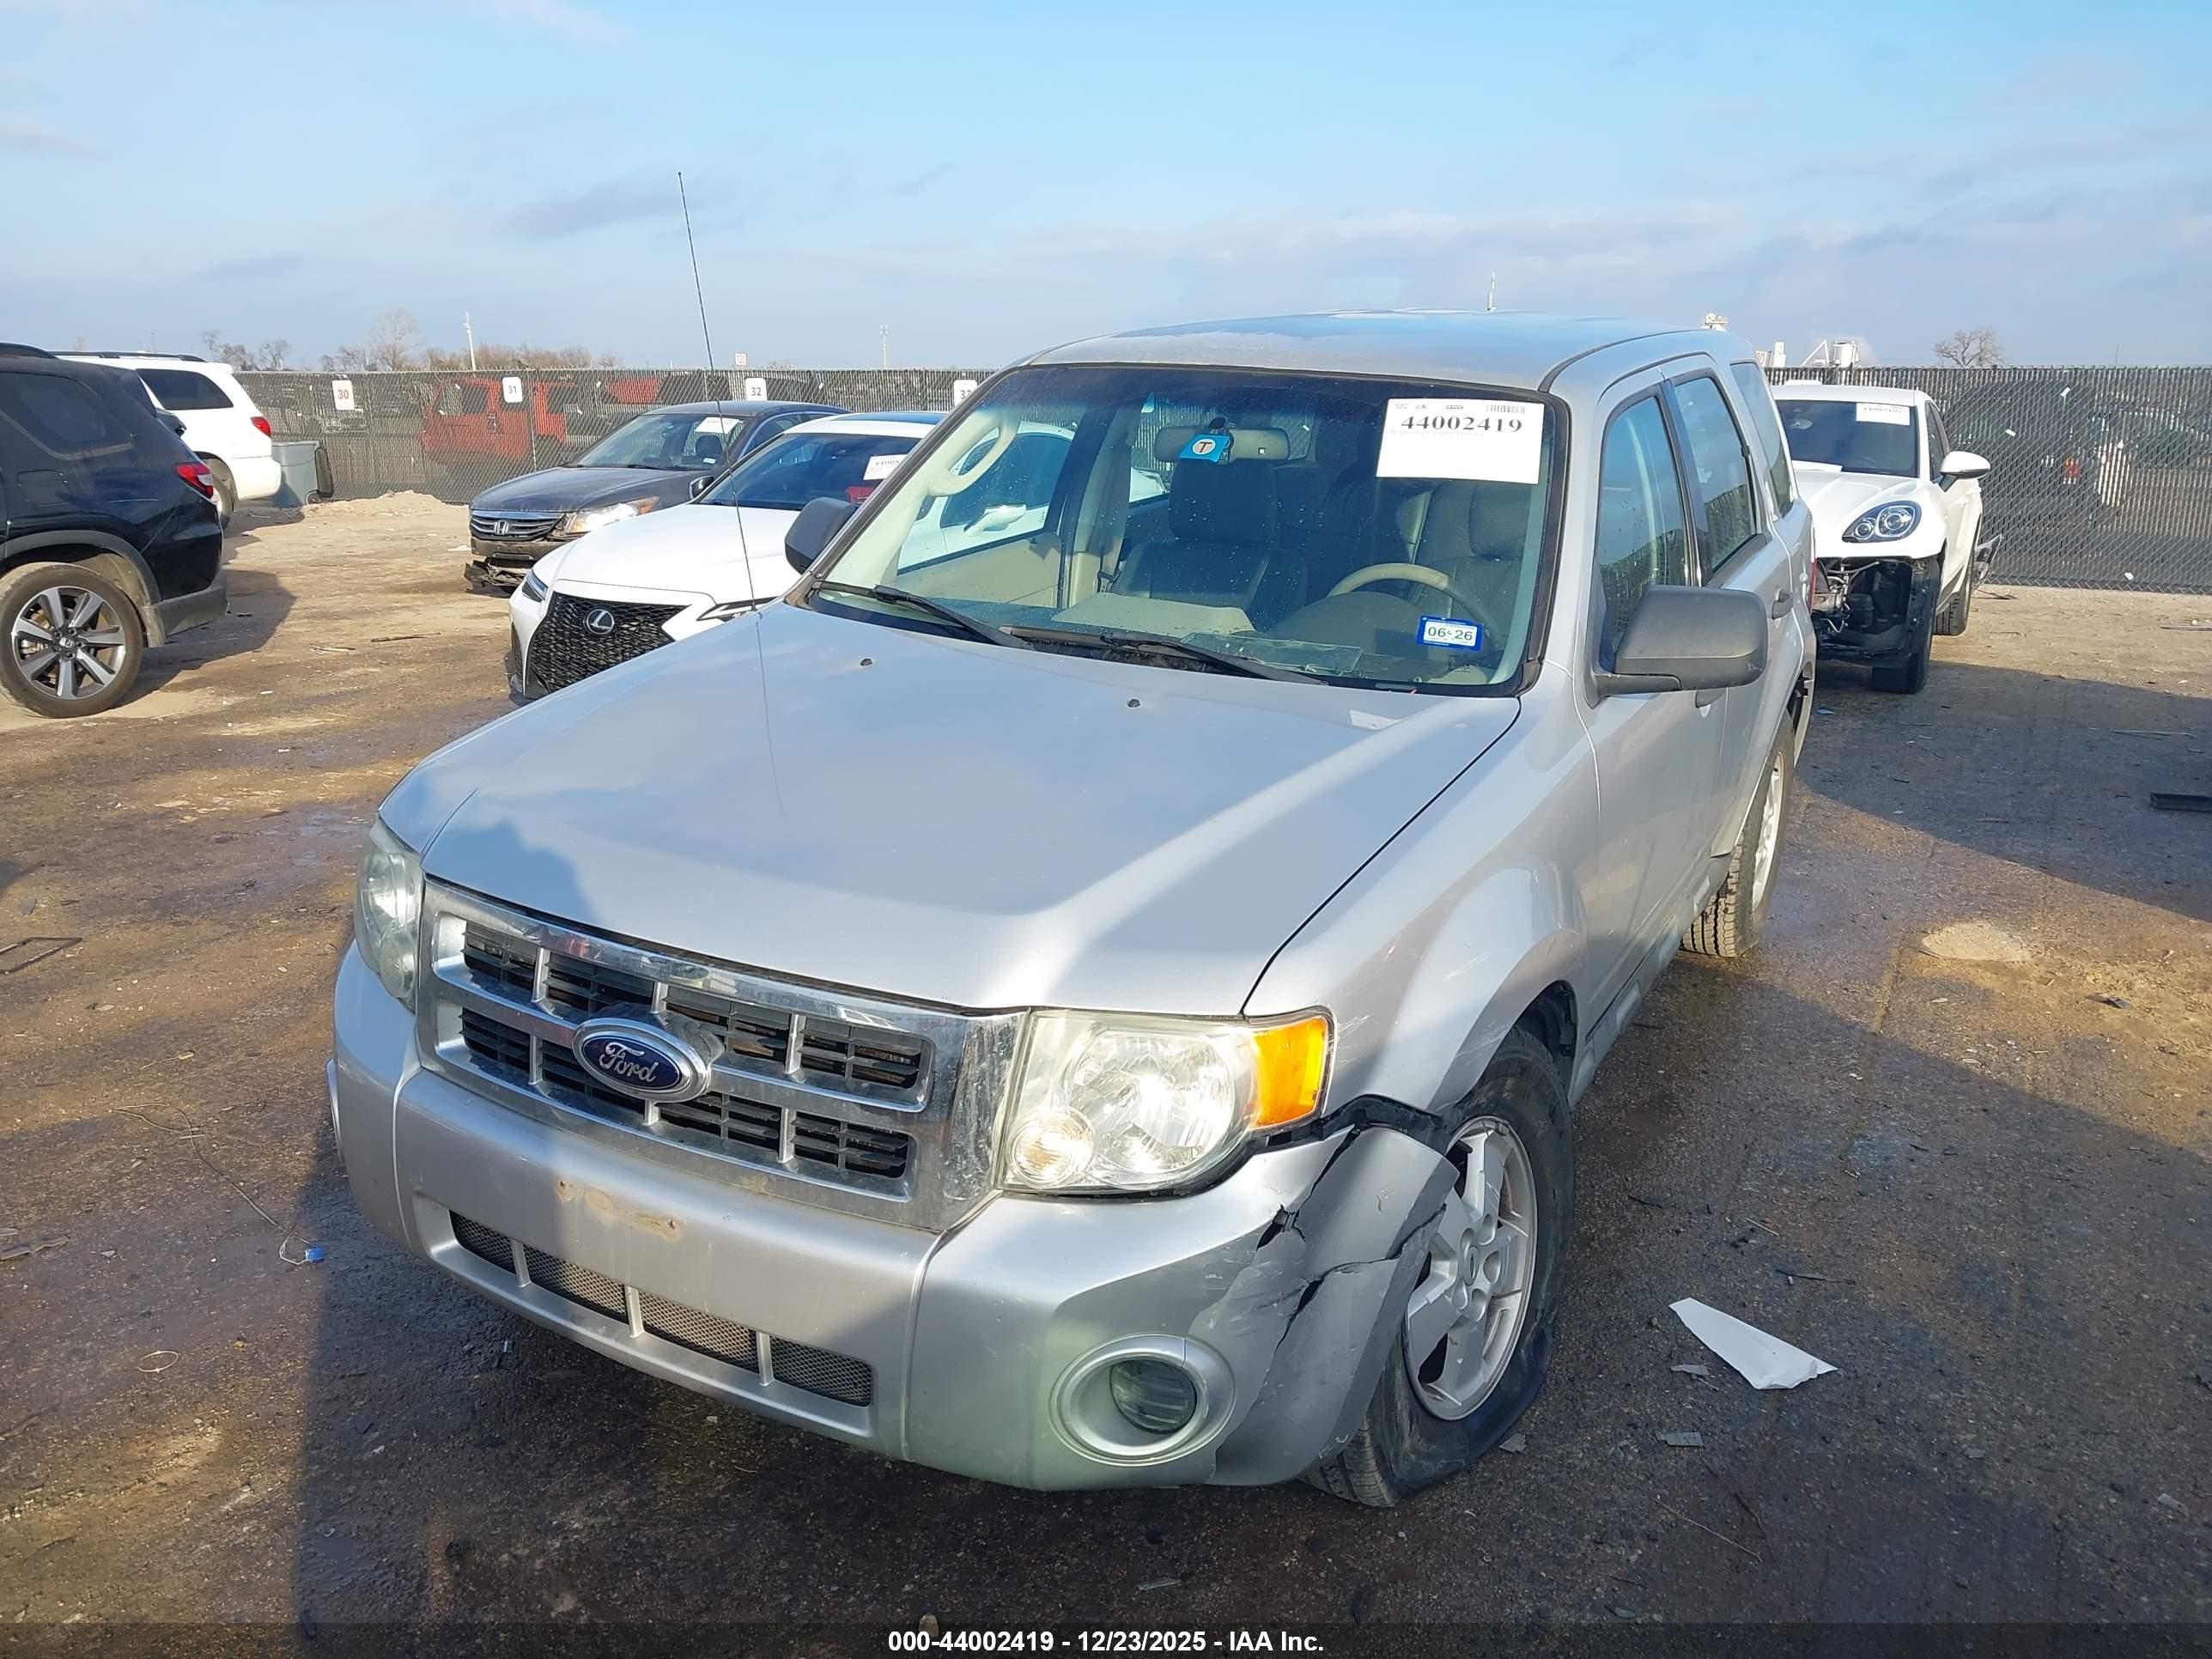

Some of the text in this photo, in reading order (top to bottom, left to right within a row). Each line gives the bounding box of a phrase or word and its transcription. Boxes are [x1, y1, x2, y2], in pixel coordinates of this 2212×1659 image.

[507, 382, 518, 394] 31
[750, 386, 762, 397] 32
[337, 389, 349, 400] 30
[1401, 416, 1522, 433] 44002419
[599, 1041, 659, 1083] Ford
